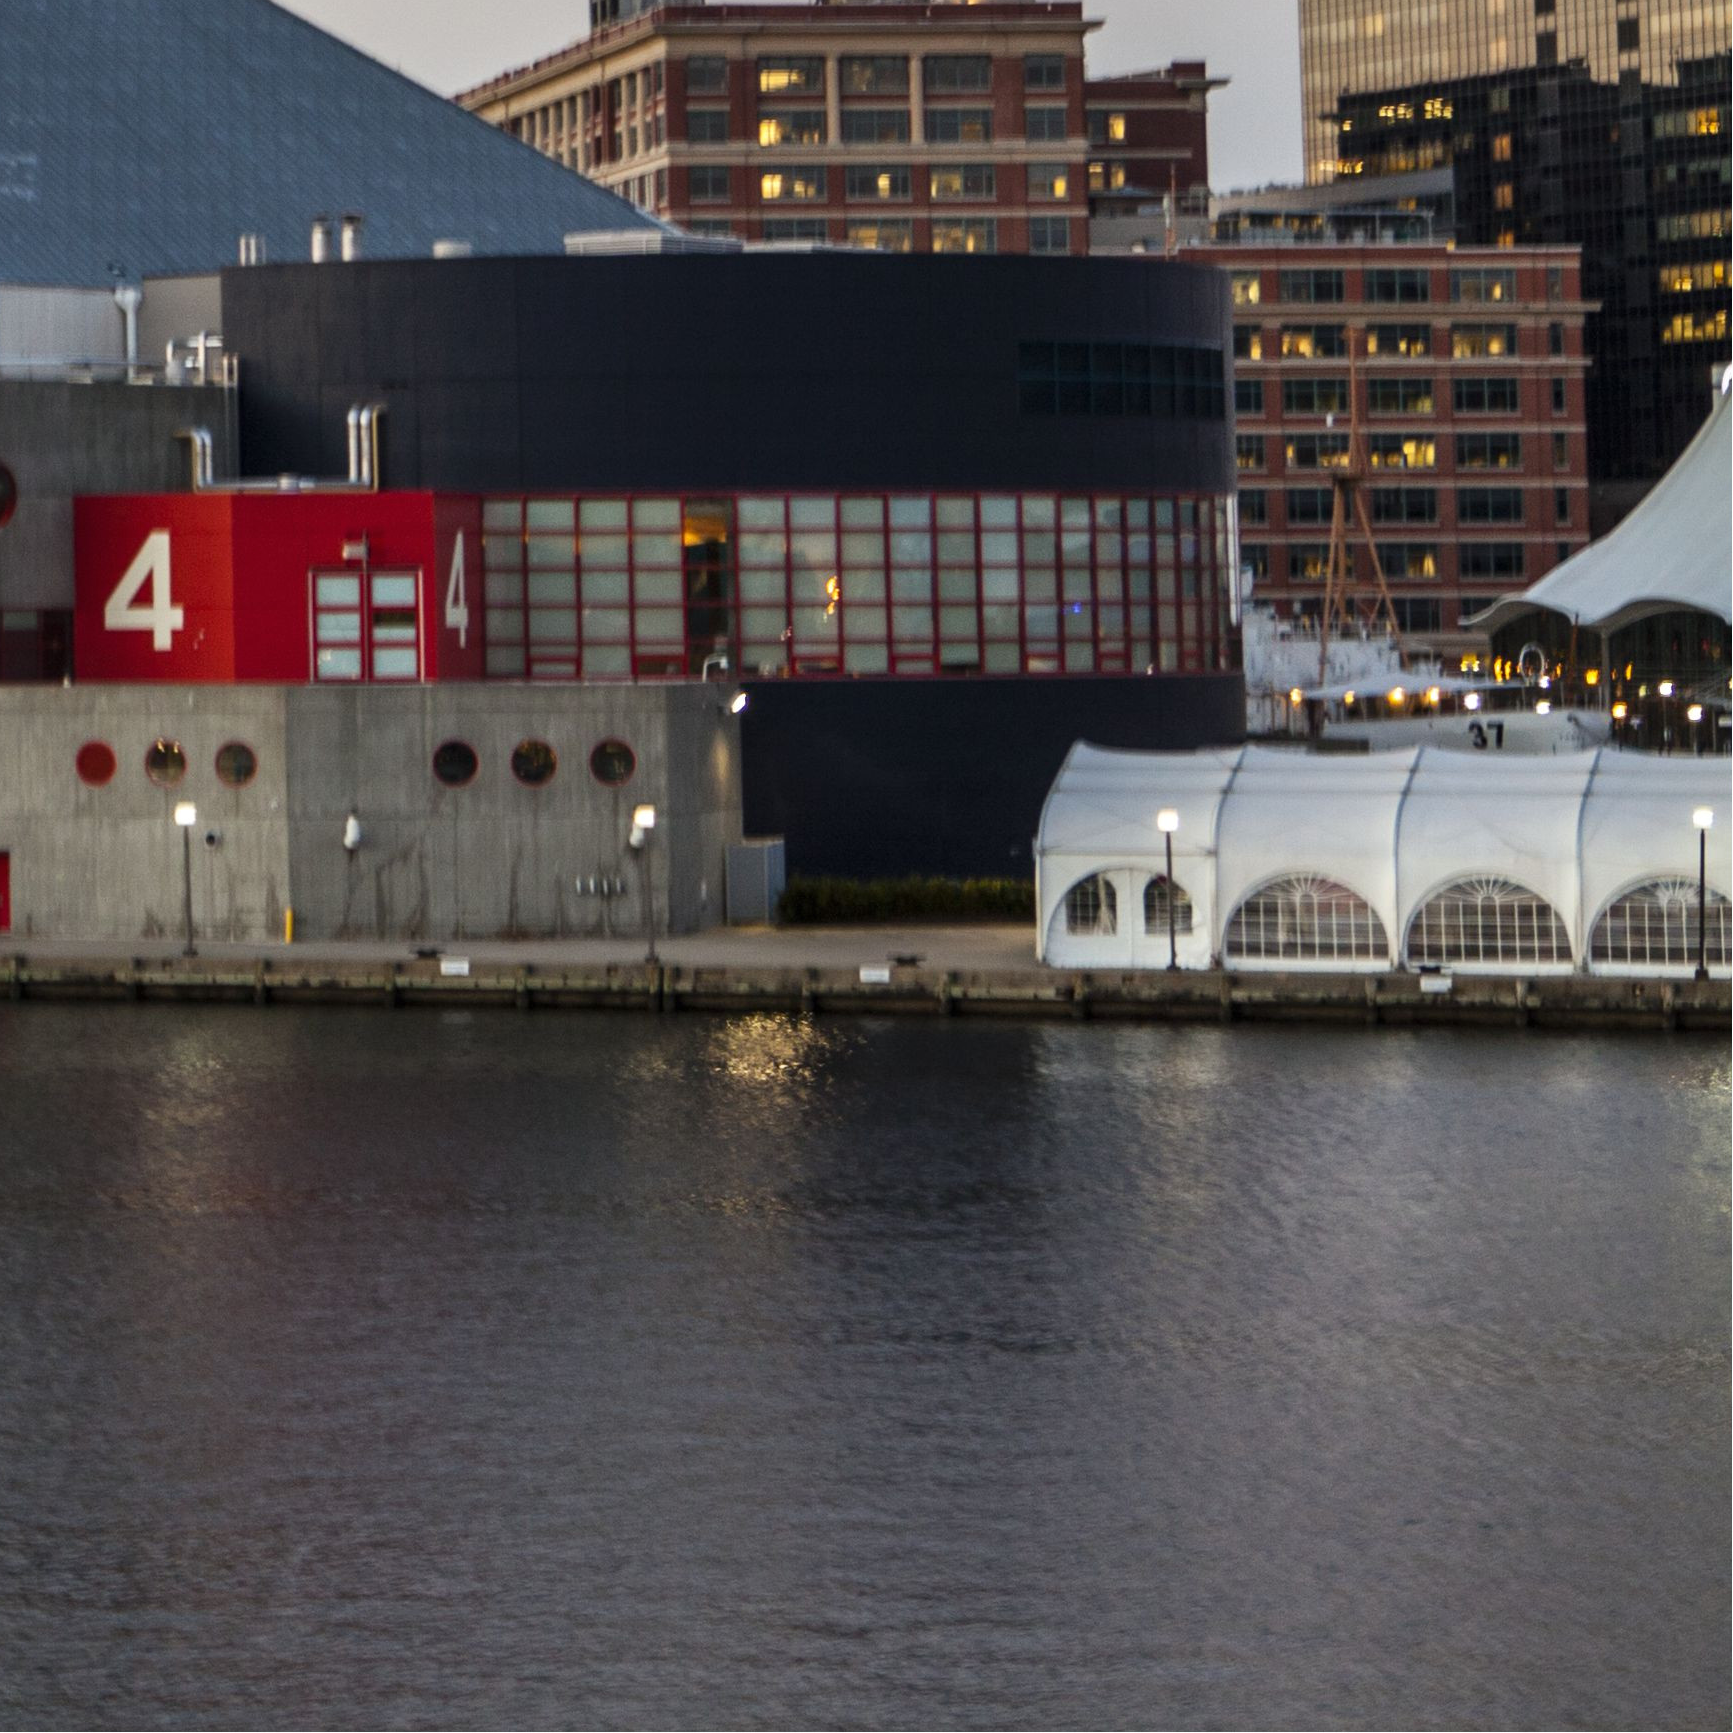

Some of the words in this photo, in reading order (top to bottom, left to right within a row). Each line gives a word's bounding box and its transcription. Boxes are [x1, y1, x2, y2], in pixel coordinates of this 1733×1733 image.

[104, 528, 184, 652] 4
[445, 527, 469, 649] 4
[1468, 720, 1504, 749] 37
